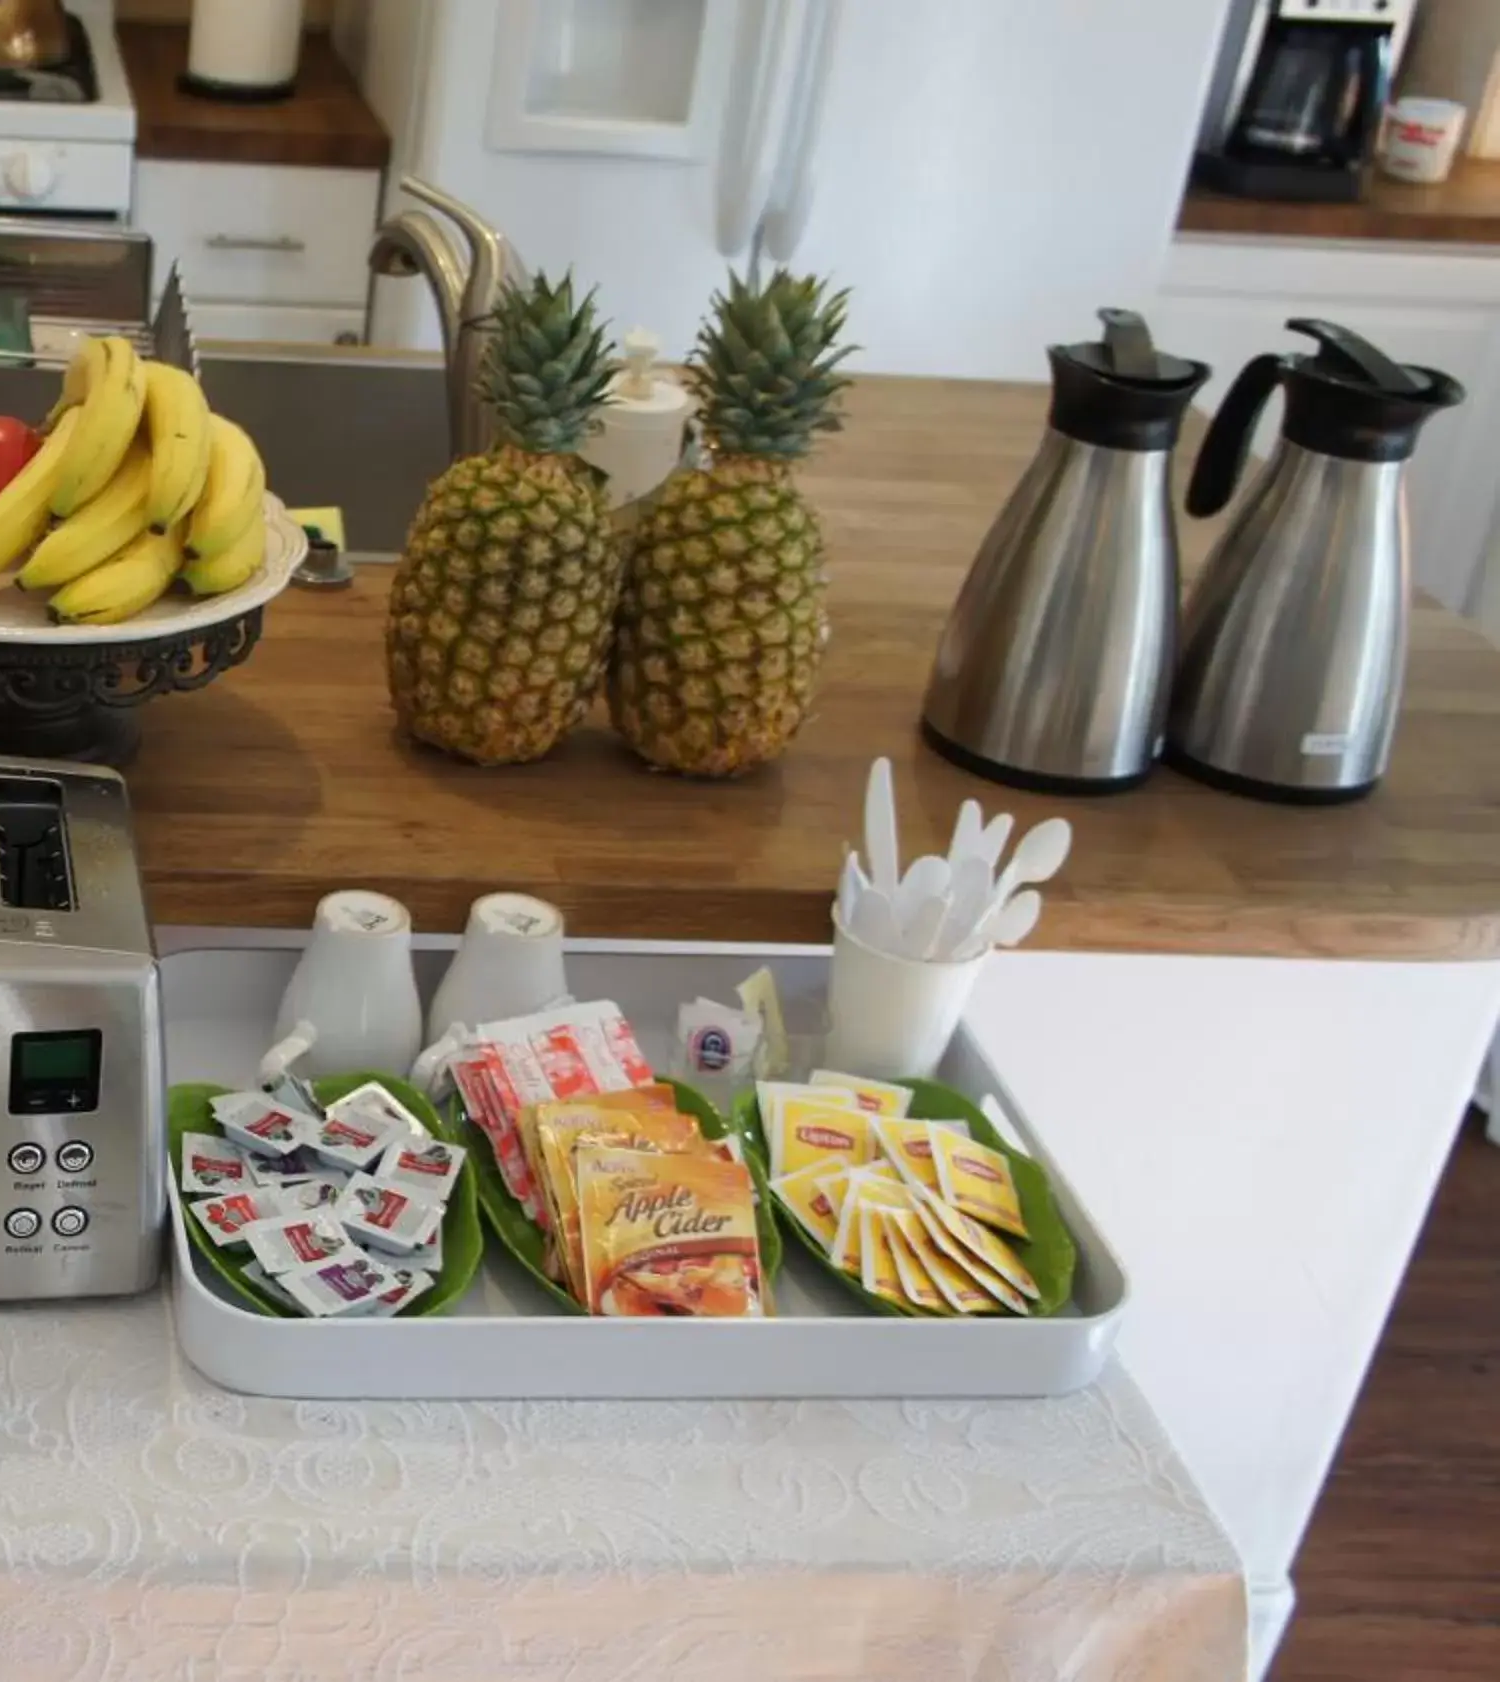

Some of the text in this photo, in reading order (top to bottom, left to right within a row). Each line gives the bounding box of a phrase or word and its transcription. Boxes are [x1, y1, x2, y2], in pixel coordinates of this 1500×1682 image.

[800, 1126, 852, 1148] Lipton
[604, 1185, 692, 1227] Apple
[653, 1208, 733, 1238] Cider
